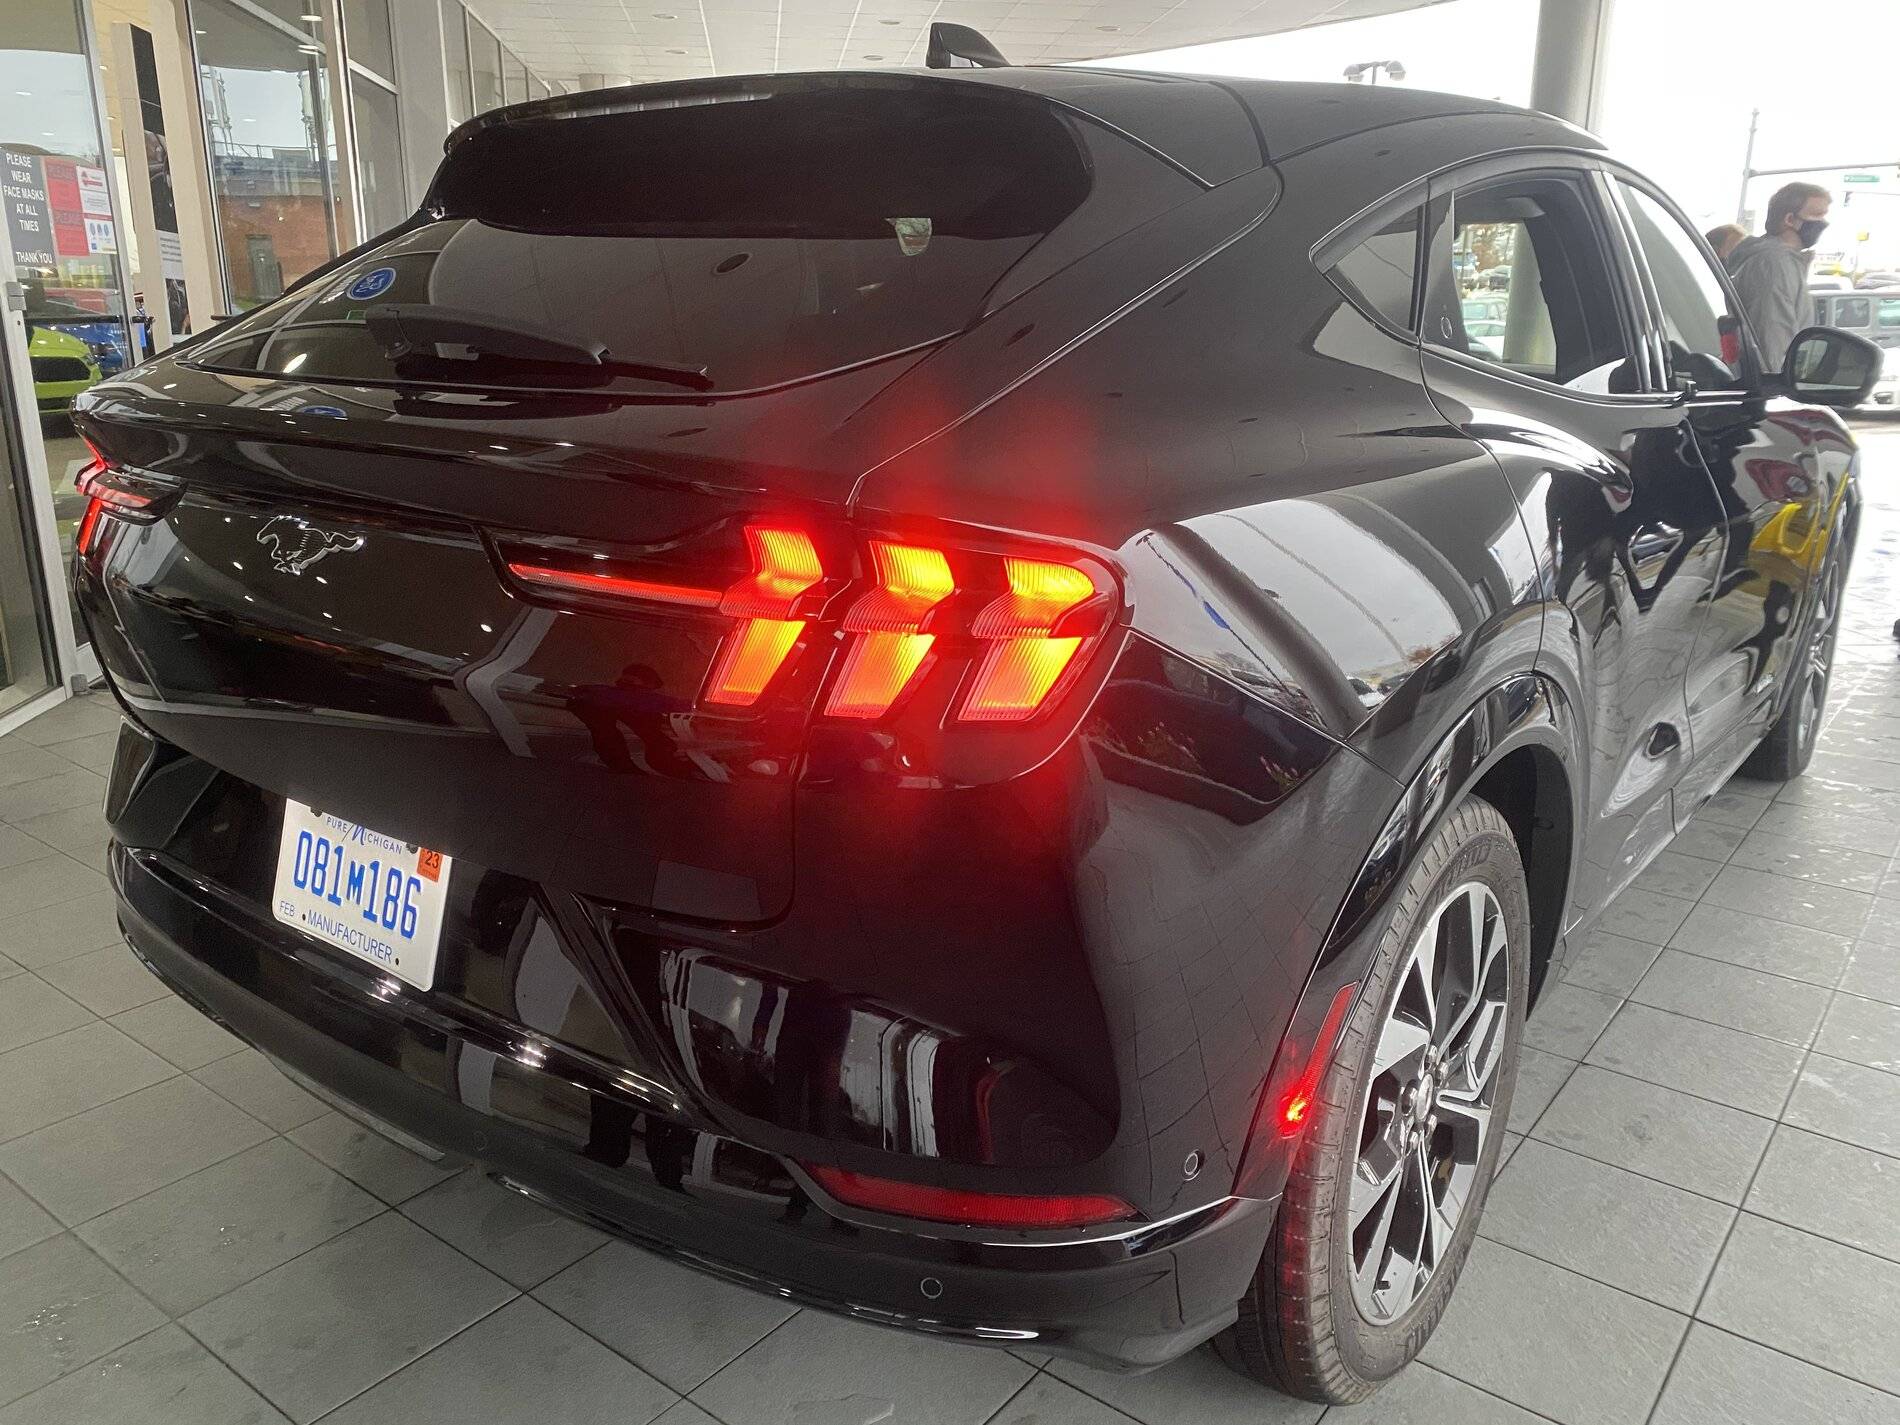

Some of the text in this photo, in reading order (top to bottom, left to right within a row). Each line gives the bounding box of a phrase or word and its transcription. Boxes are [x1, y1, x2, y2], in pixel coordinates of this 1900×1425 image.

[6, 153, 32, 168] PLEASE
[11, 170, 32, 183] WEAR
[3, 185, 45, 200] FACE MASKS
[16, 203, 38, 216] AT ALL
[19, 219, 39, 232] TIMES
[16, 251, 53, 264] THANK YOU
[326, 816, 402, 854] PURE MICHIGAN
[425, 850, 440, 869] 23
[293, 830, 422, 940] 081M186
[279, 900, 295, 917] FEB
[306, 911, 393, 964] MANUFACTURER
